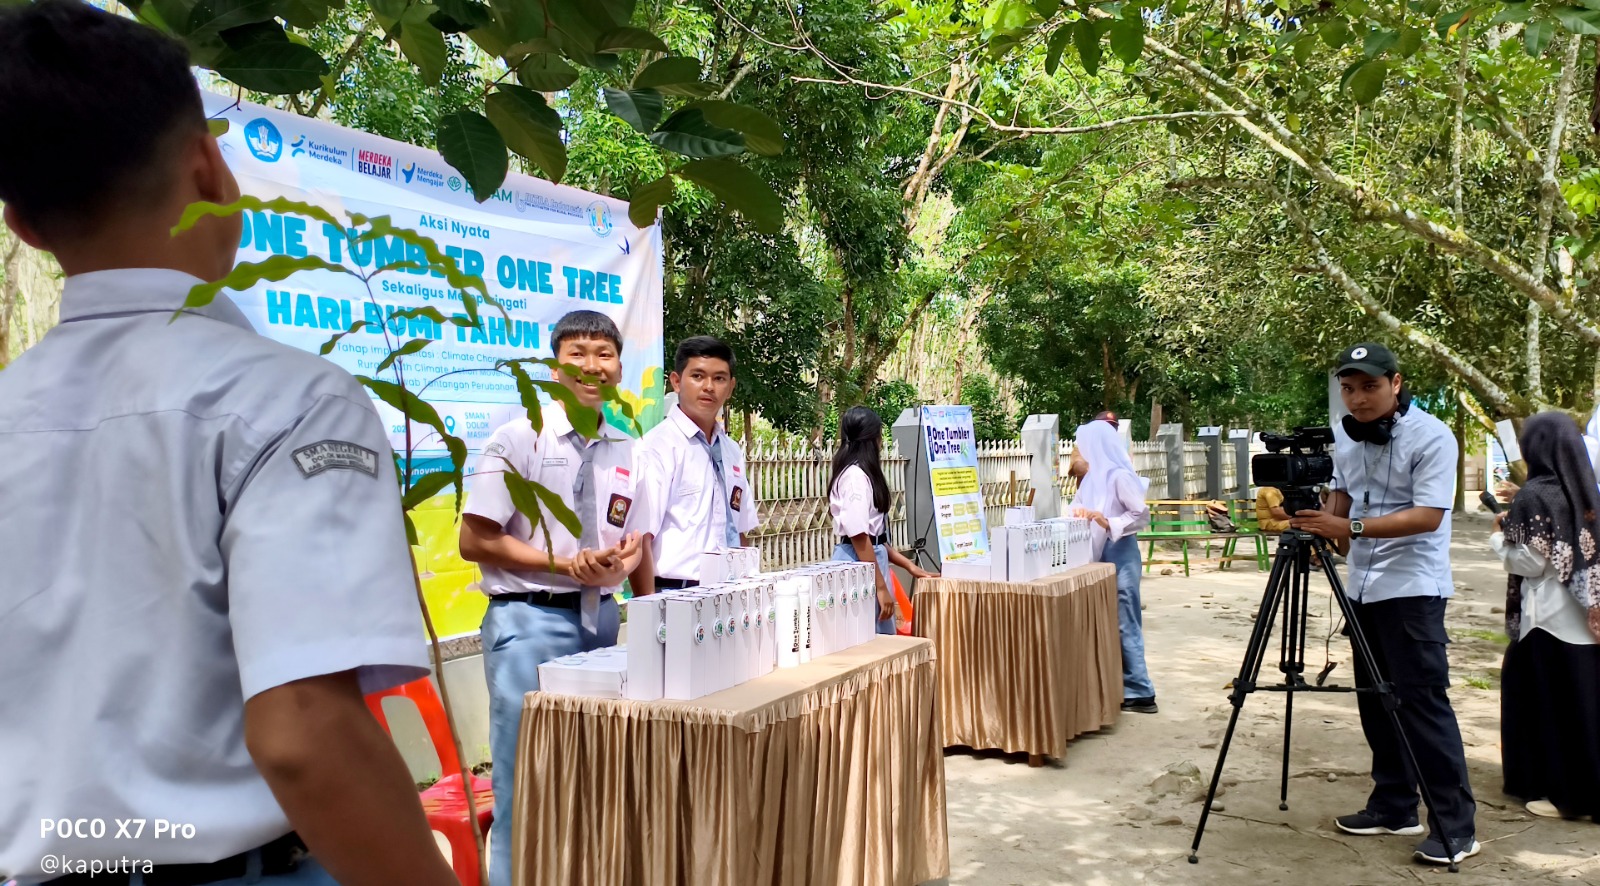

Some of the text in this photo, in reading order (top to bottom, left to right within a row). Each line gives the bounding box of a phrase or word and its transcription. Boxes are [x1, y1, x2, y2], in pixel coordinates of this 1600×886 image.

[308, 140, 348, 157] Kurikulum
[308, 150, 342, 165] Merdeka
[358, 149, 392, 168] MERDEKA
[358, 160, 392, 180] BELAJAR
[417, 167, 443, 180] Merdeka
[416, 174, 444, 188] Mengajar
[465, 182, 512, 203] RAM
[419, 213, 490, 240] Aksi Nyata
[496, 254, 554, 295] ONE
[562, 265, 624, 305] TREE
[382, 279, 444, 301] Sekaligus
[266, 288, 353, 331] HARI
[363, 300, 443, 341] BUMI
[452, 312, 540, 349] TAHUN
[336, 342, 368, 355] Tahap
[441, 350, 475, 362] Climate
[414, 363, 449, 374] Climate
[471, 381, 515, 391] Perubahan
[464, 411, 486, 420] SMAN
[466, 421, 489, 429] DOLOK
[932, 426, 969, 440] One Tumbler
[303, 444, 328, 459] SMA
[934, 440, 961, 454] One Tree
